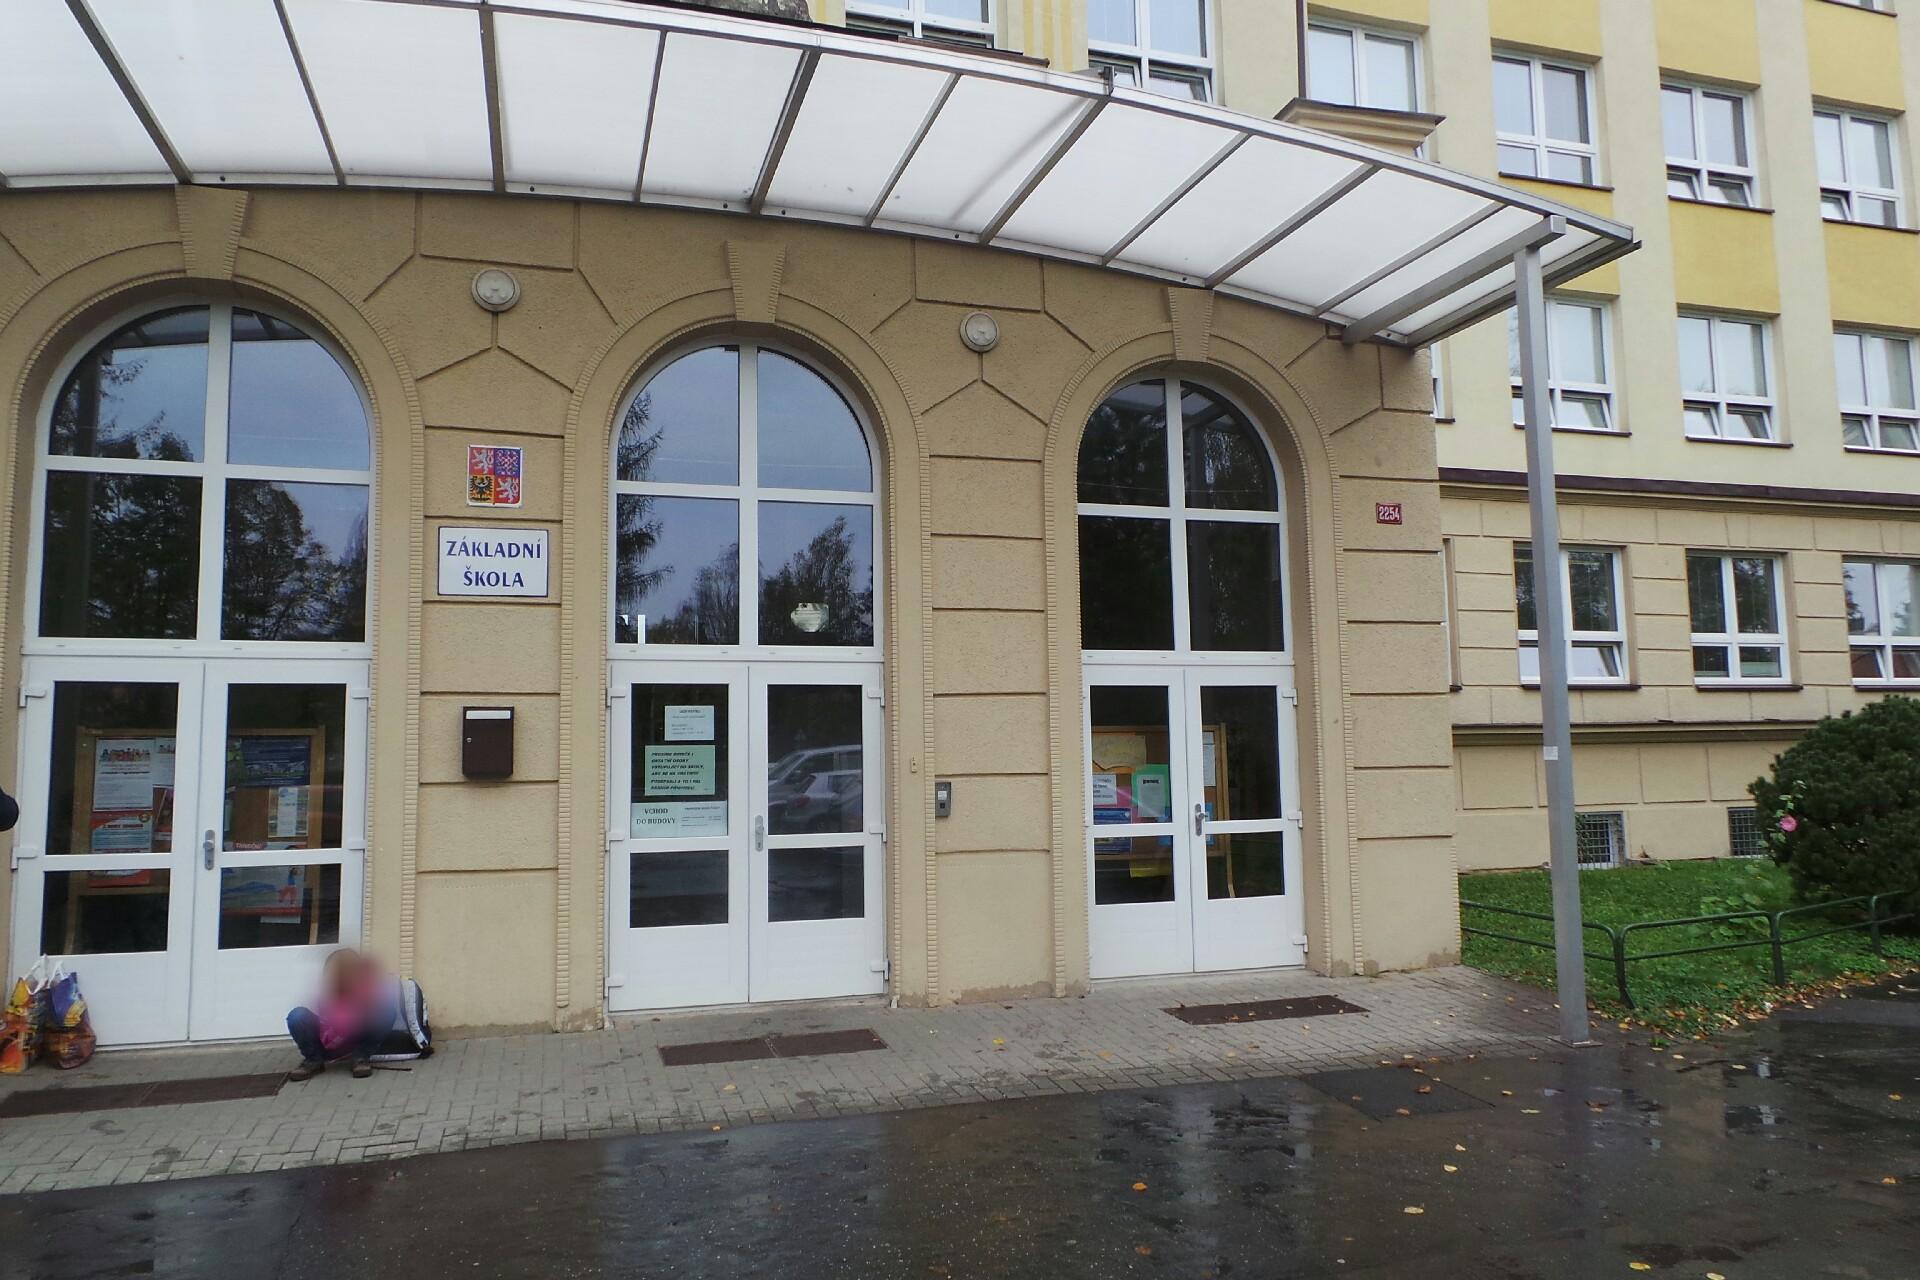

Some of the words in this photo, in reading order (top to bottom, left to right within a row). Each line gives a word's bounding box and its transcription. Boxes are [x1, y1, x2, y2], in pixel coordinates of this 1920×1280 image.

[1378, 506, 1400, 520] 2254
[446, 536, 541, 559] ZÁKLADNÍ
[463, 564, 524, 588] ŠKOLA
[644, 807, 669, 815] VCHOD
[647, 817, 676, 825] BUDOVY
